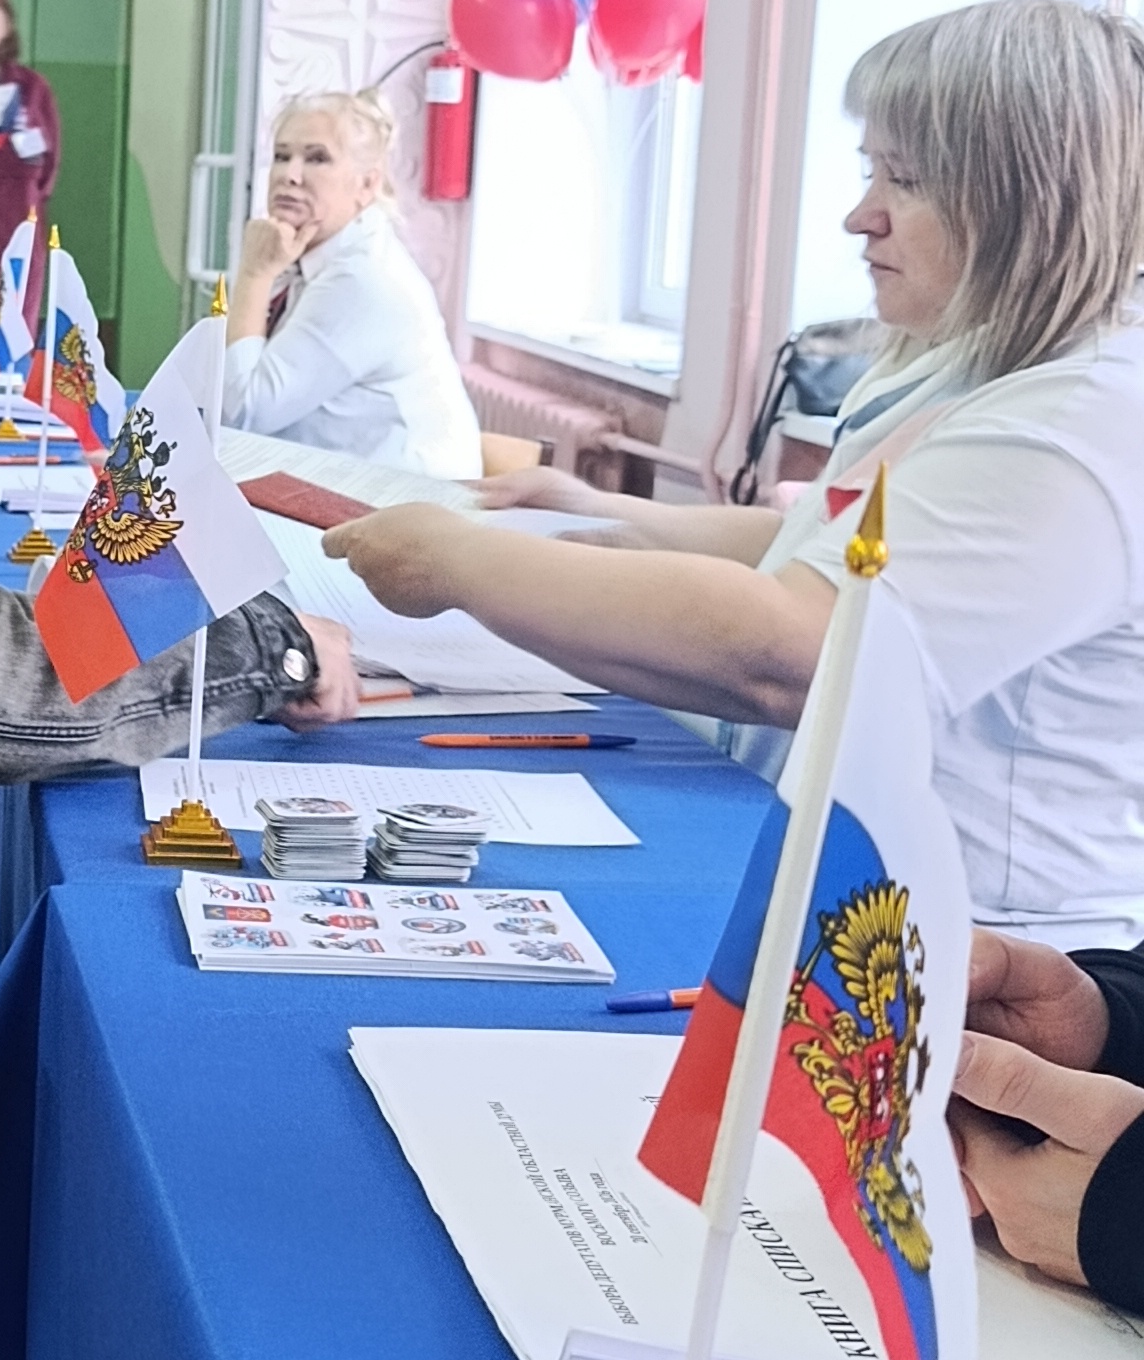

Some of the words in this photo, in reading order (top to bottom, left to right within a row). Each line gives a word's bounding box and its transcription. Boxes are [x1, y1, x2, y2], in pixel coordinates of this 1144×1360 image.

[499, 1121, 540, 1174] ОБЛАСТНОЙ
[553, 1167, 583, 1202] СОЗЫВА
[566, 1230, 616, 1283] ДЕПУТАТОВ
[740, 1209, 815, 1283] СПИСКА
[599, 1283, 639, 1325] ВЫБОРЫ
[799, 1289, 879, 1359] КНИГА
